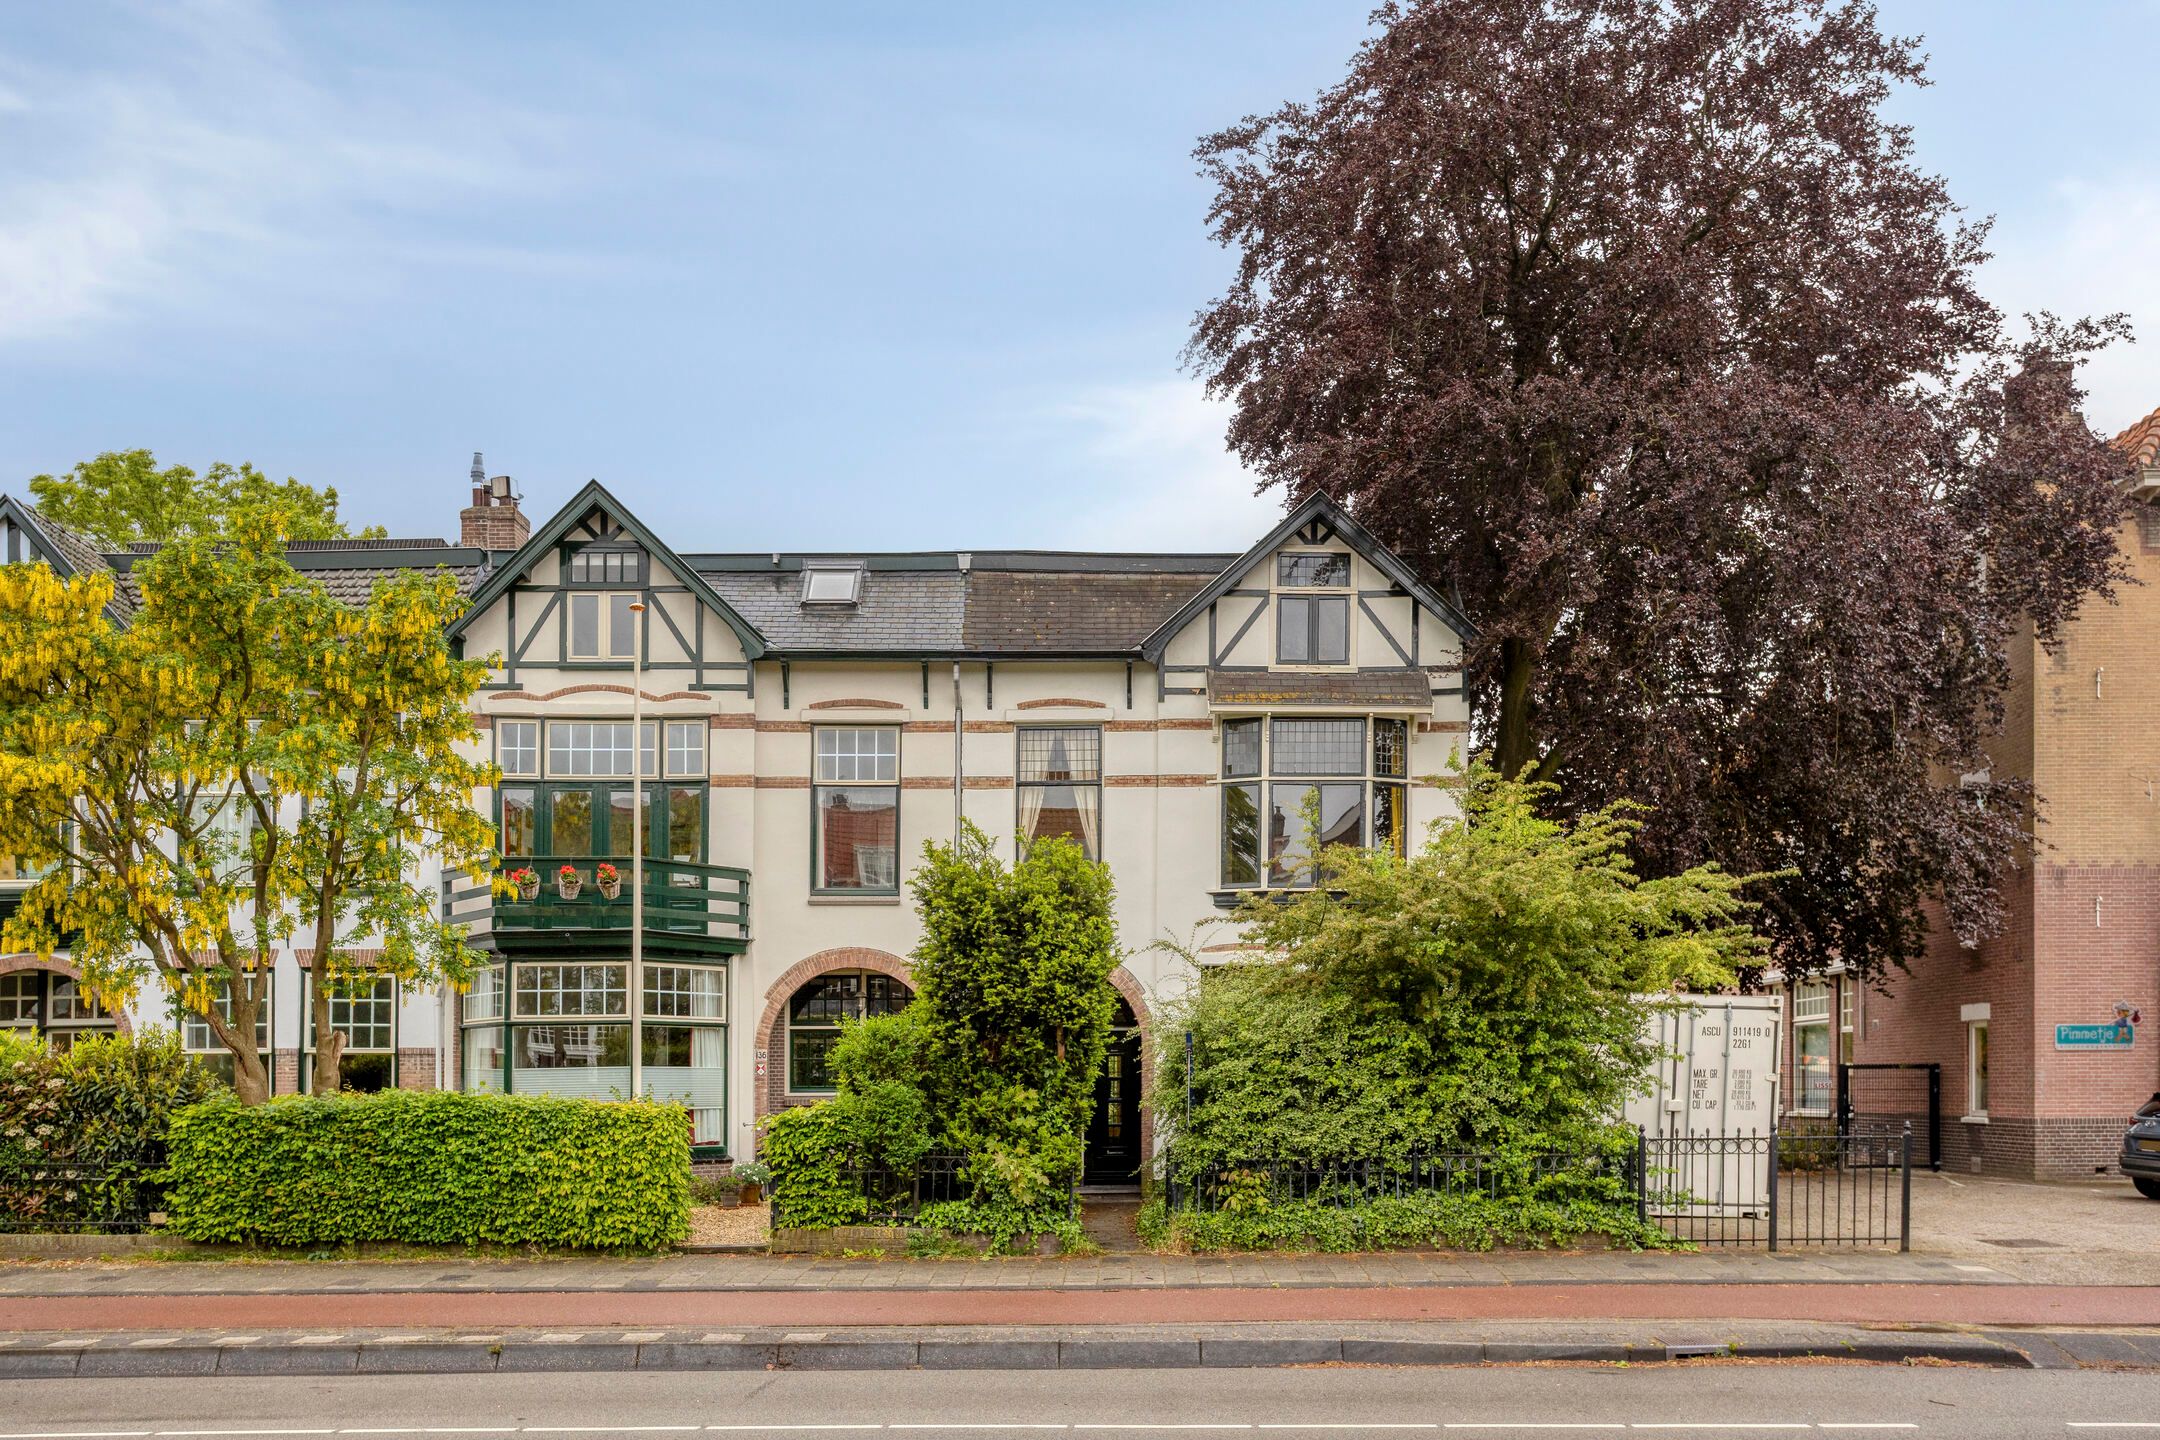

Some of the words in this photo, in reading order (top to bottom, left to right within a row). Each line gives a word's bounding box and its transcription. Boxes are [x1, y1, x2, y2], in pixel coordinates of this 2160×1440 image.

[1701, 1026, 1721, 1036] ASCU
[1733, 1026, 1761, 1037] 911419
[1765, 1027, 1771, 1037] 0
[2060, 1026, 2114, 1043] Pimmetje
[1694, 1079, 1708, 1089] TARE
[1693, 1090, 1705, 1099] NET
